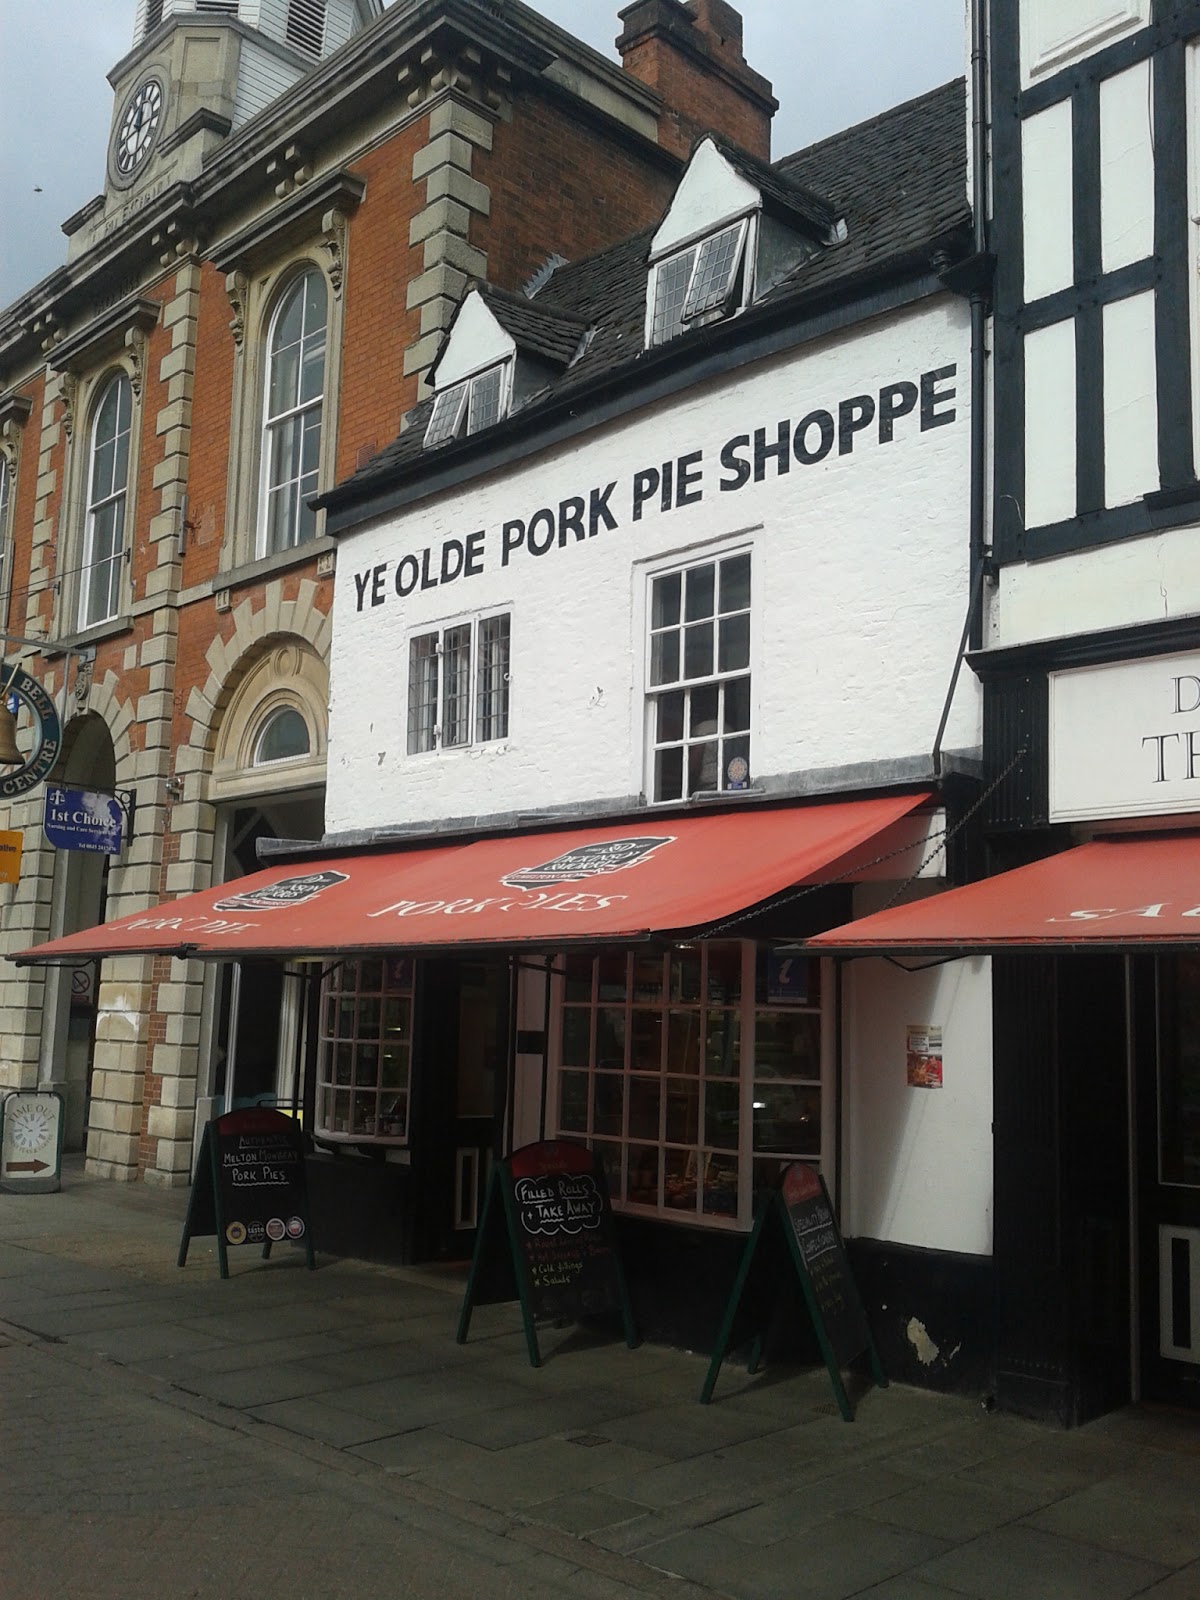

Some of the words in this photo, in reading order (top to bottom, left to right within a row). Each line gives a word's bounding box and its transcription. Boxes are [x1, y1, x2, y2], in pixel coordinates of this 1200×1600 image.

[354, 563, 387, 613] YE
[395, 529, 486, 596] OLDE
[501, 480, 618, 567] PORK
[632, 450, 704, 522] PIE
[720, 362, 958, 492] SHOPPE
[20, 677, 54, 721] BELL
[3, 739, 57, 794] CENTRE
[50, 808, 69, 822] 1st
[72, 811, 117, 828] Choice
[366, 897, 514, 918] PORK
[499, 892, 629, 913] PIES
[9, 1104, 31, 1123] TIME
[35, 1104, 57, 1121] OUT
[224, 1152, 258, 1164] MELTON
[232, 1168, 257, 1181] PORK
[263, 1166, 286, 1181] PIES
[521, 1184, 555, 1200] FILLED
[558, 1180, 589, 1197] ROLLS
[535, 1204, 565, 1218] TAKE
[567, 1200, 597, 1215] AWAY
[542, 1275, 572, 1287] Salads
